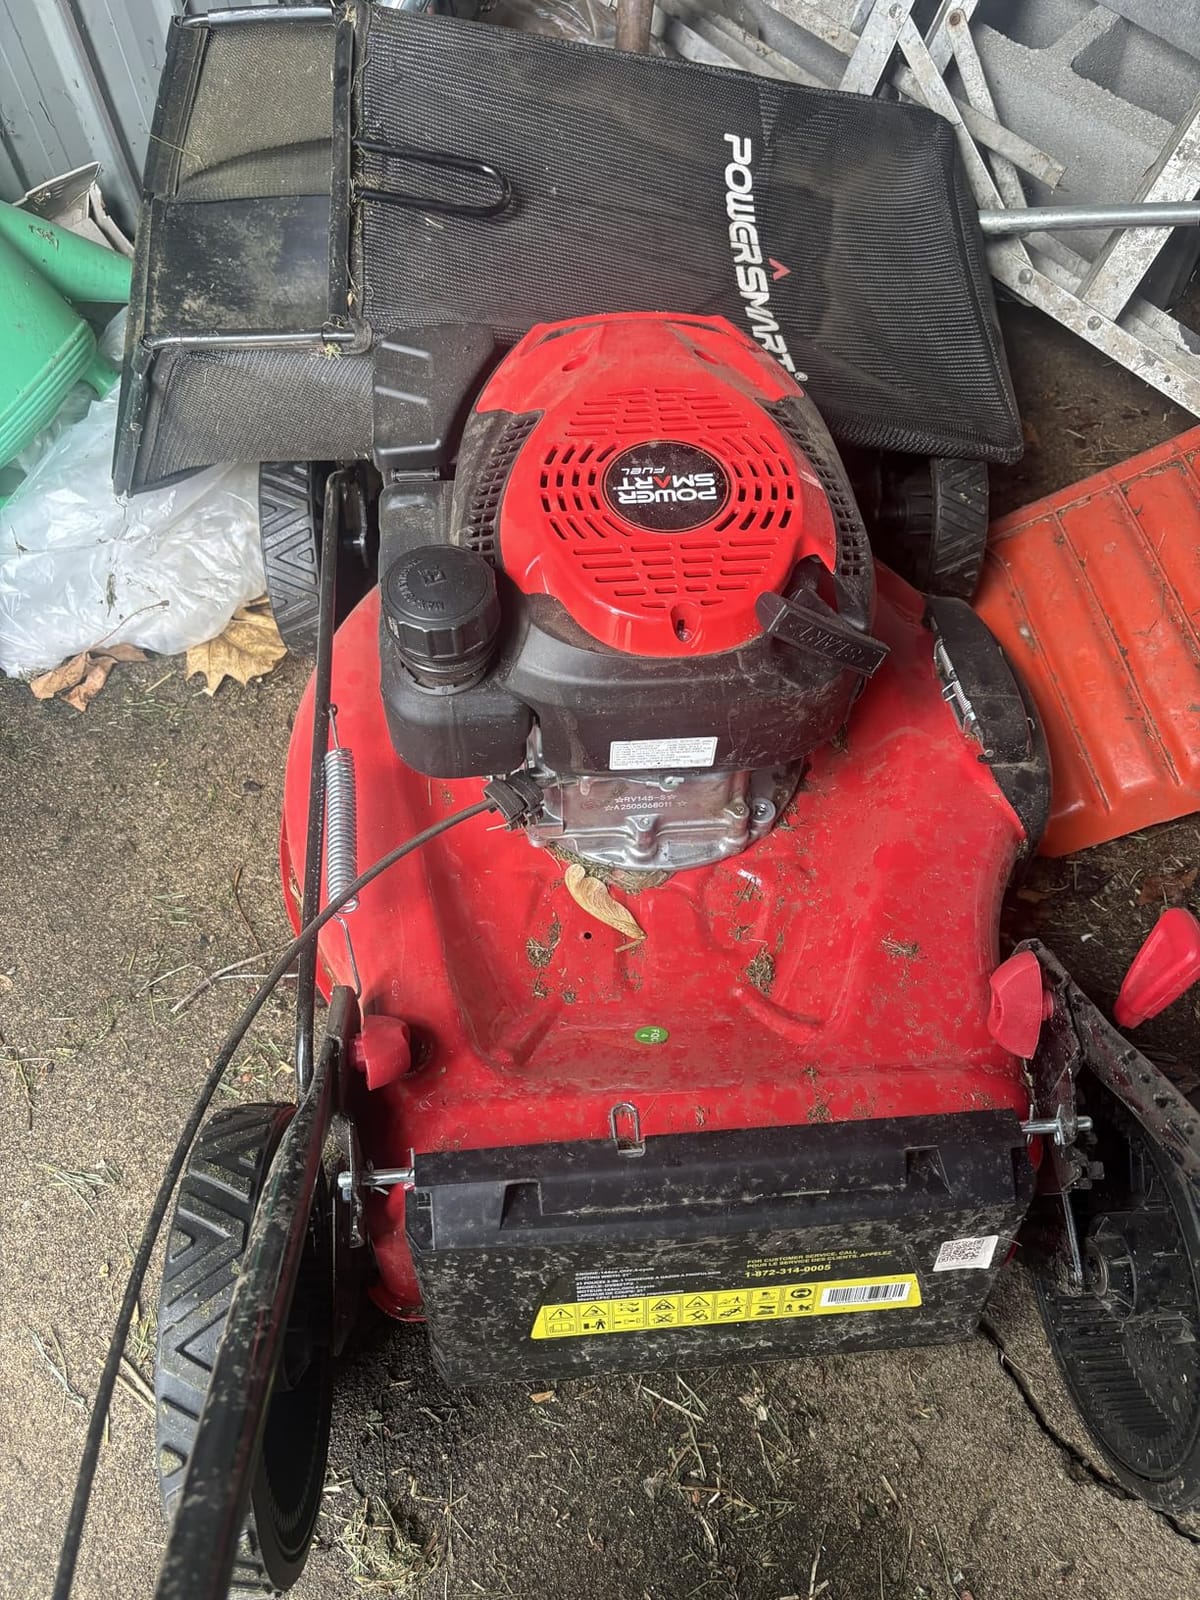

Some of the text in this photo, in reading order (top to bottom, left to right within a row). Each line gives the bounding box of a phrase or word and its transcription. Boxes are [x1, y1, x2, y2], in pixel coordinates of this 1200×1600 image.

[724, 133, 796, 374] POWERSMART
[621, 466, 666, 475] FUEL
[614, 473, 715, 490] SMART
[618, 487, 718, 504] POWER
[763, 1255, 804, 1263] CUSTOMER
[779, 1258, 810, 1266] SERVICE
[745, 1264, 832, 1278] 1-872-314-0005
